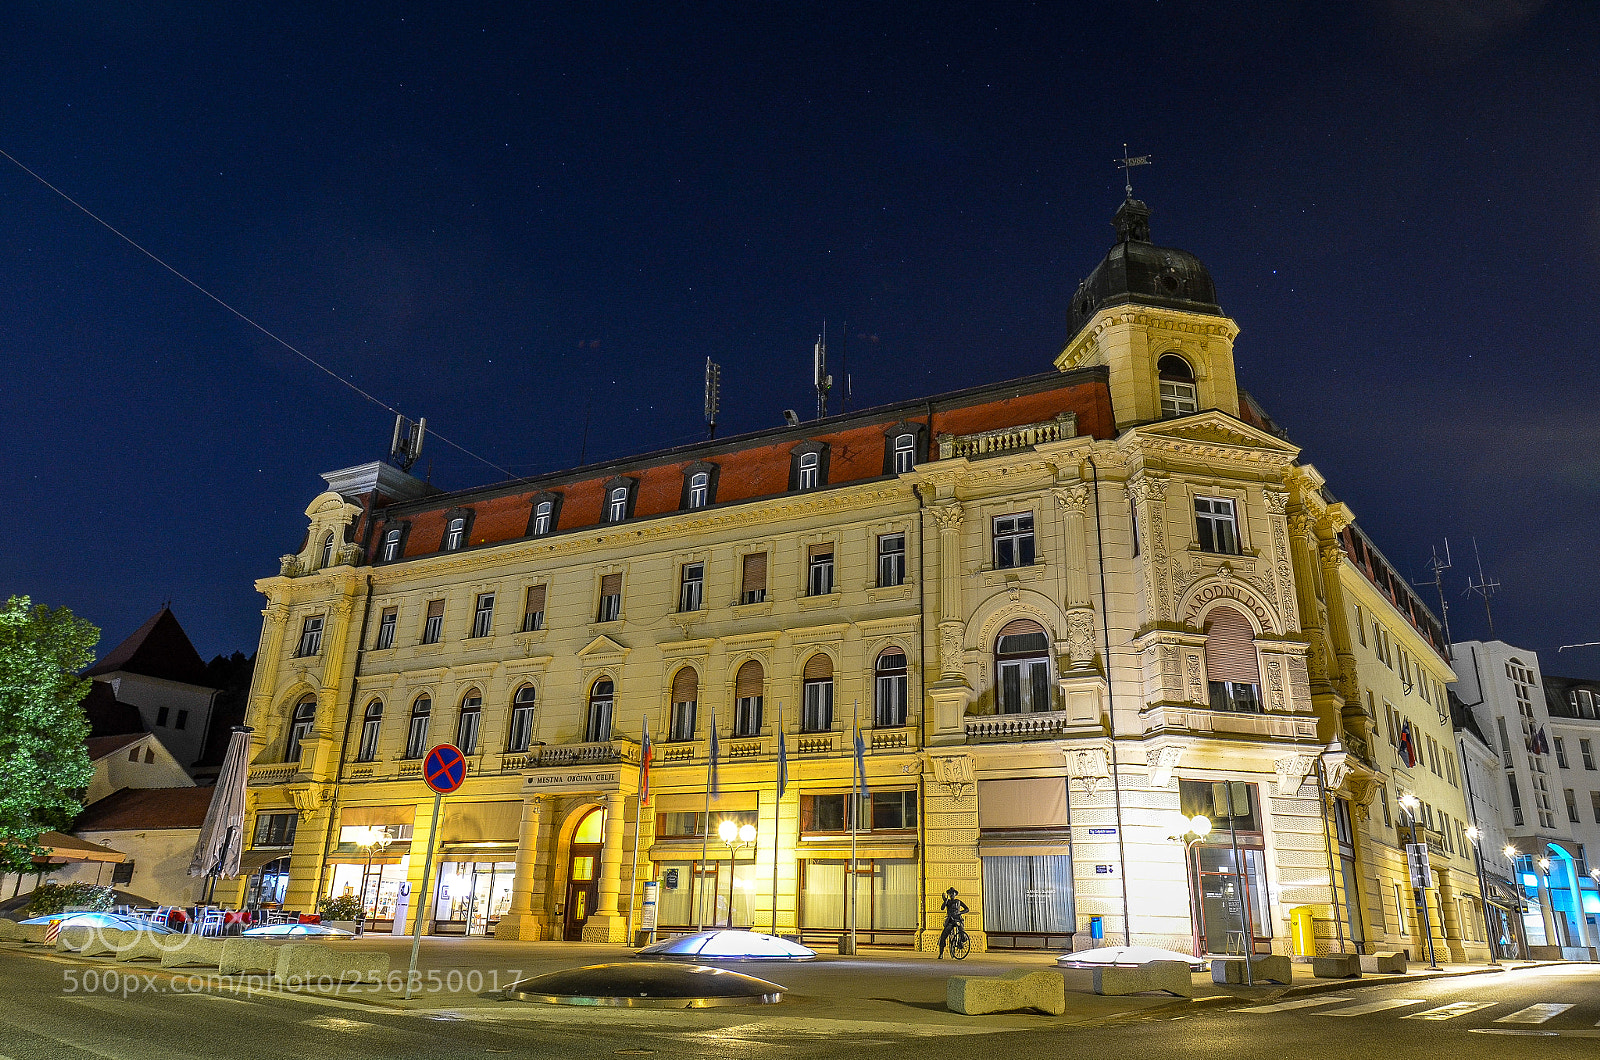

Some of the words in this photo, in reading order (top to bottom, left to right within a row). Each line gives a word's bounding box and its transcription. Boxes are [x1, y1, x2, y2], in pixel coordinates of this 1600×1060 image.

[1185, 585, 1242, 626] NARODNI
[1245, 595, 1273, 631] DOM
[537, 776, 563, 784] MESTNA
[567, 773, 592, 782] OBČINA
[595, 773, 615, 781] CELJE
